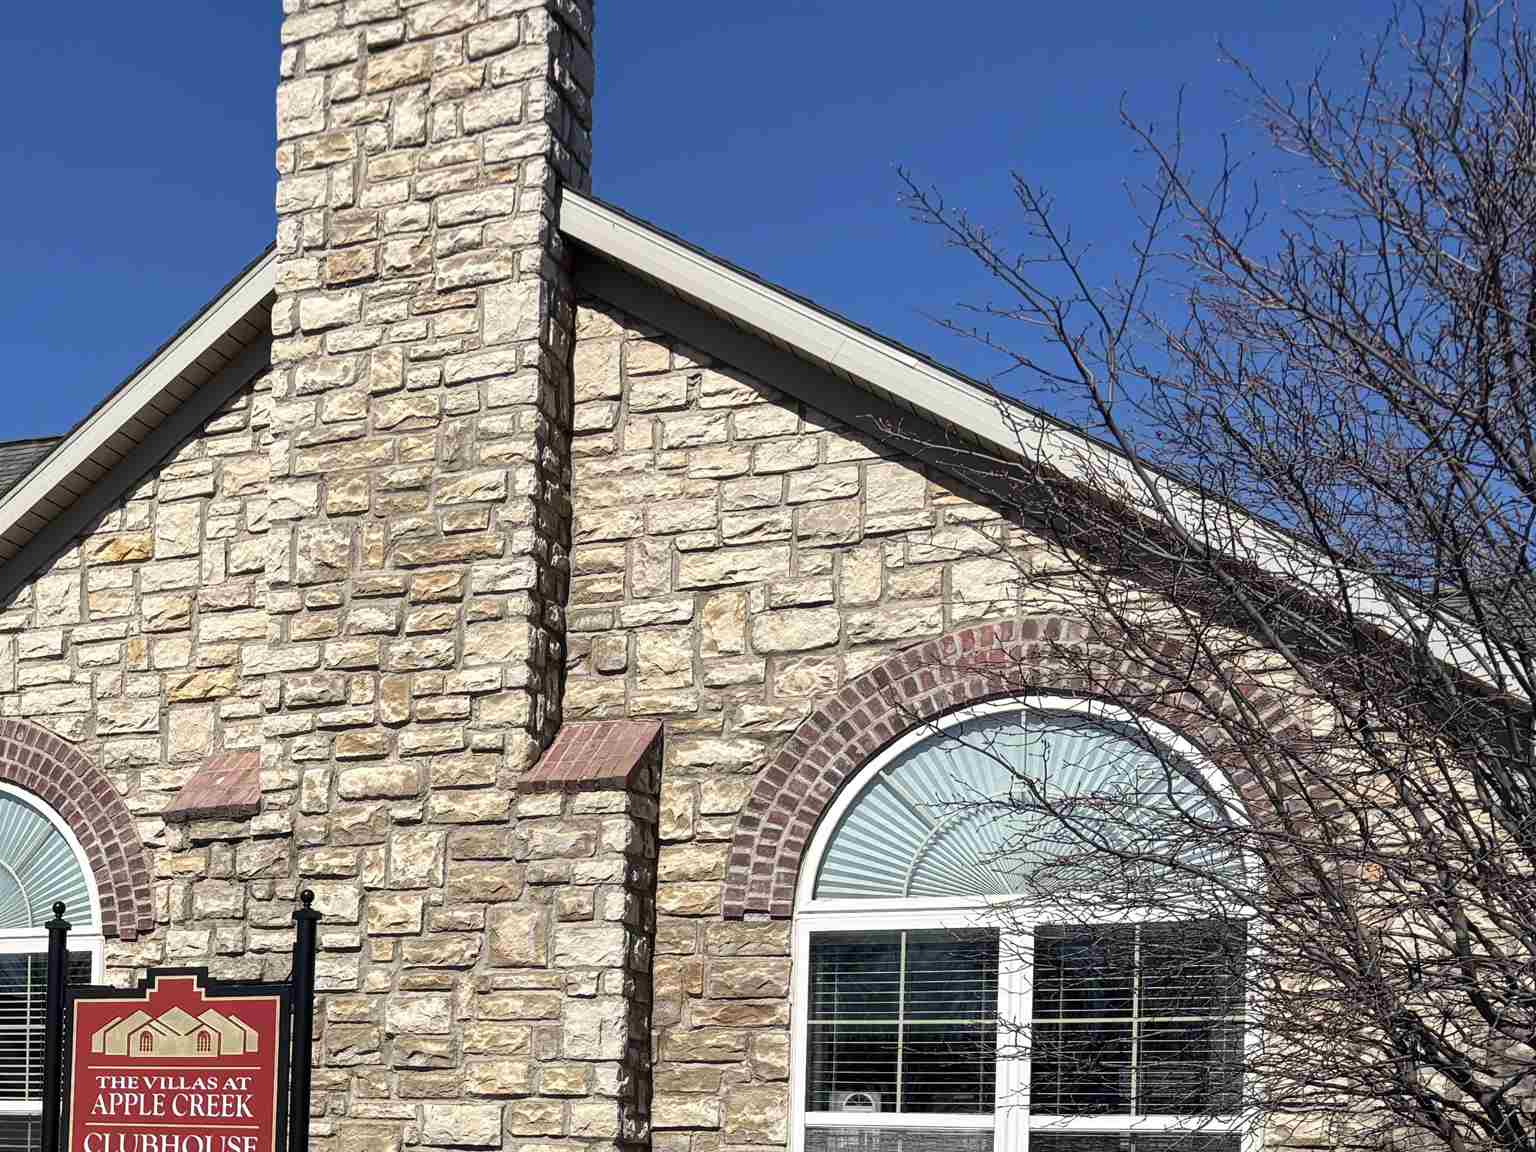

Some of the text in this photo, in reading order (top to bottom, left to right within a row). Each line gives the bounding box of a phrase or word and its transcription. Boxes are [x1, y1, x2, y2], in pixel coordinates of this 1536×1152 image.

[96, 1076, 252, 1090] THE VILLAS AT
[91, 1093, 254, 1118] APPLE CREEK
